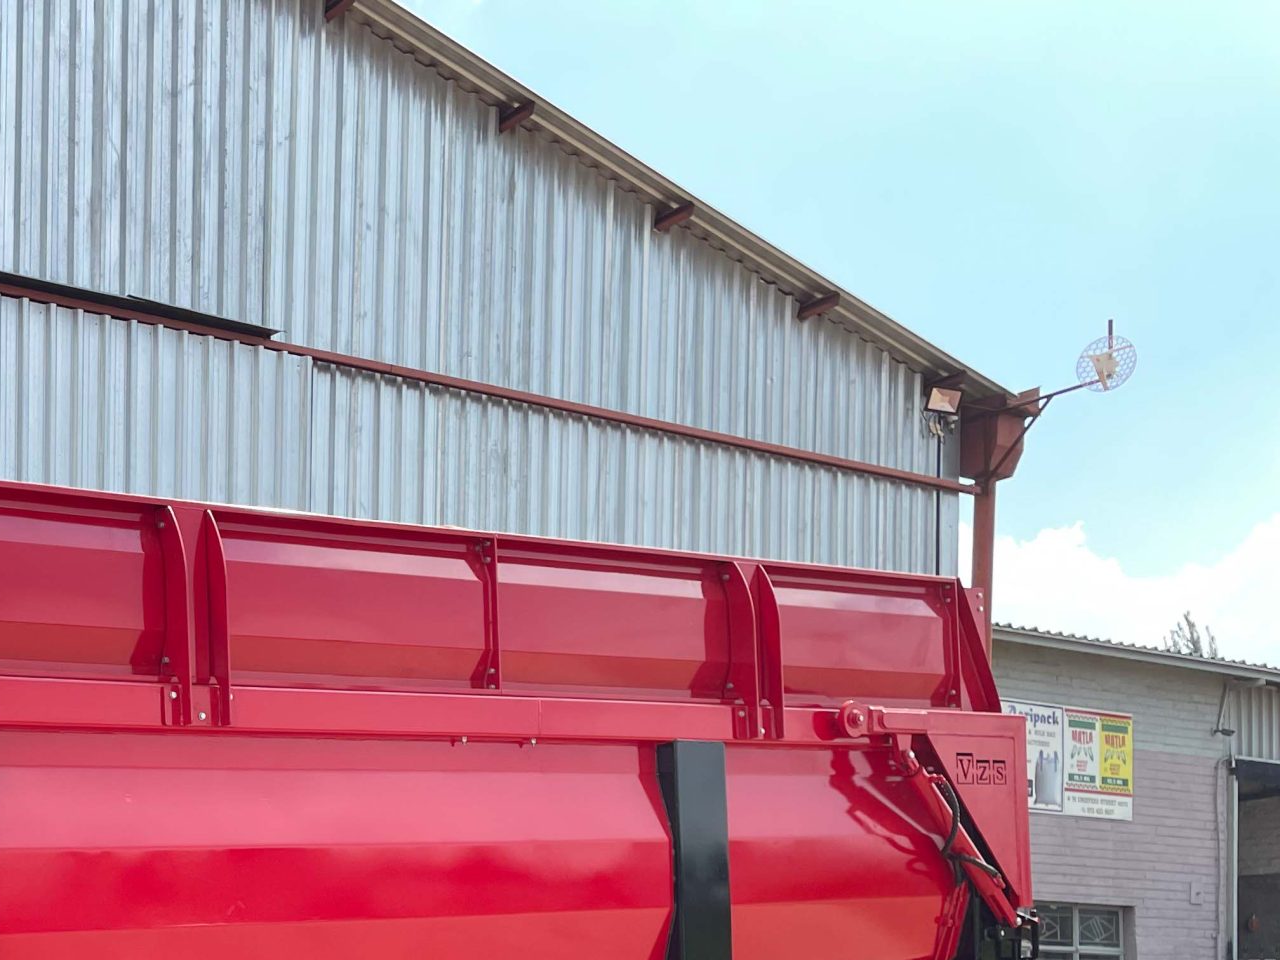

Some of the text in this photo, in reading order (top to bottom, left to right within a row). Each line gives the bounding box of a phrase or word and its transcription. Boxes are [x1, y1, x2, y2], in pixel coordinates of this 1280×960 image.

[1007, 704, 1060, 728] Aripack
[1071, 730, 1094, 745] MATLA
[1104, 734, 1126, 749] MATLA
[957, 756, 1006, 783] VZS
